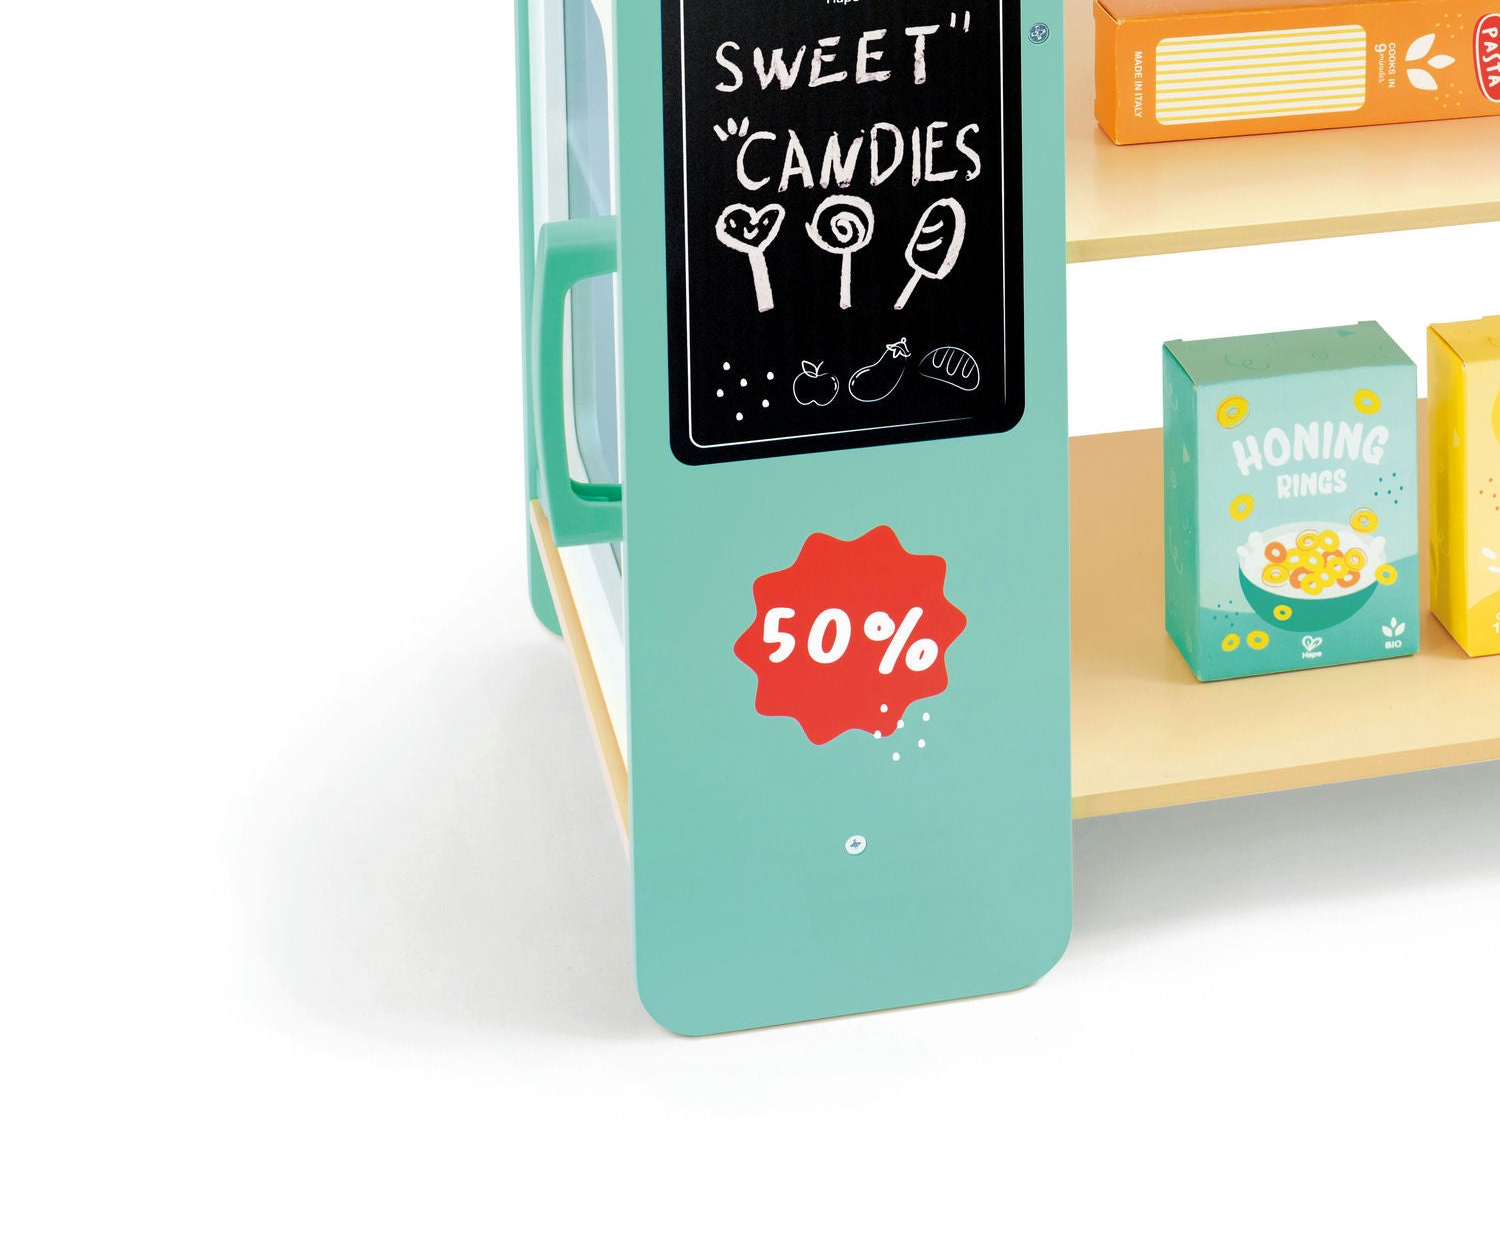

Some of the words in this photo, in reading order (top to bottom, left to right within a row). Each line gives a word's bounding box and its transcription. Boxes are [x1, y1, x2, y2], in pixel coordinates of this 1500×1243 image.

[1134, 50, 1143, 79] MADE
[1388, 42, 1396, 75] COOKS
[1134, 80, 1143, 91] IN
[1388, 79, 1396, 88] IN
[1134, 93, 1143, 118] ITALY
[1232, 421, 1390, 476] HONING
[1277, 468, 1347, 500] RINGS
[763, 606, 939, 675] 50%
[1385, 640, 1402, 649] BIO
